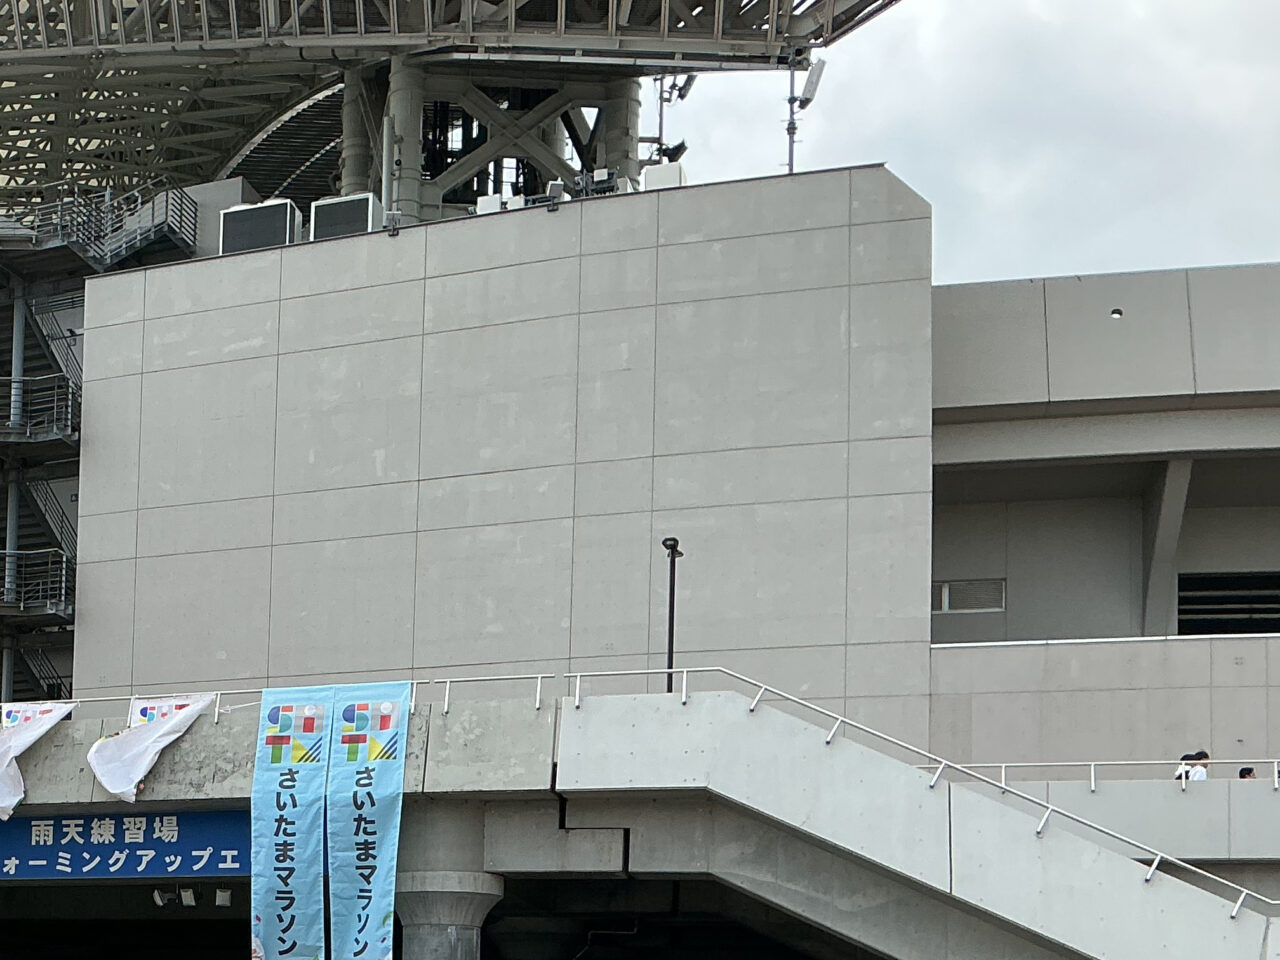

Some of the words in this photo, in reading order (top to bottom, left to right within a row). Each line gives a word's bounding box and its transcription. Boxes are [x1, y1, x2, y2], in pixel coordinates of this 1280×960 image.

[30, 816, 179, 846] 雨天練習場
[273, 768, 300, 956] さいたまマラソン
[353, 766, 377, 958] さいたまマラソン
